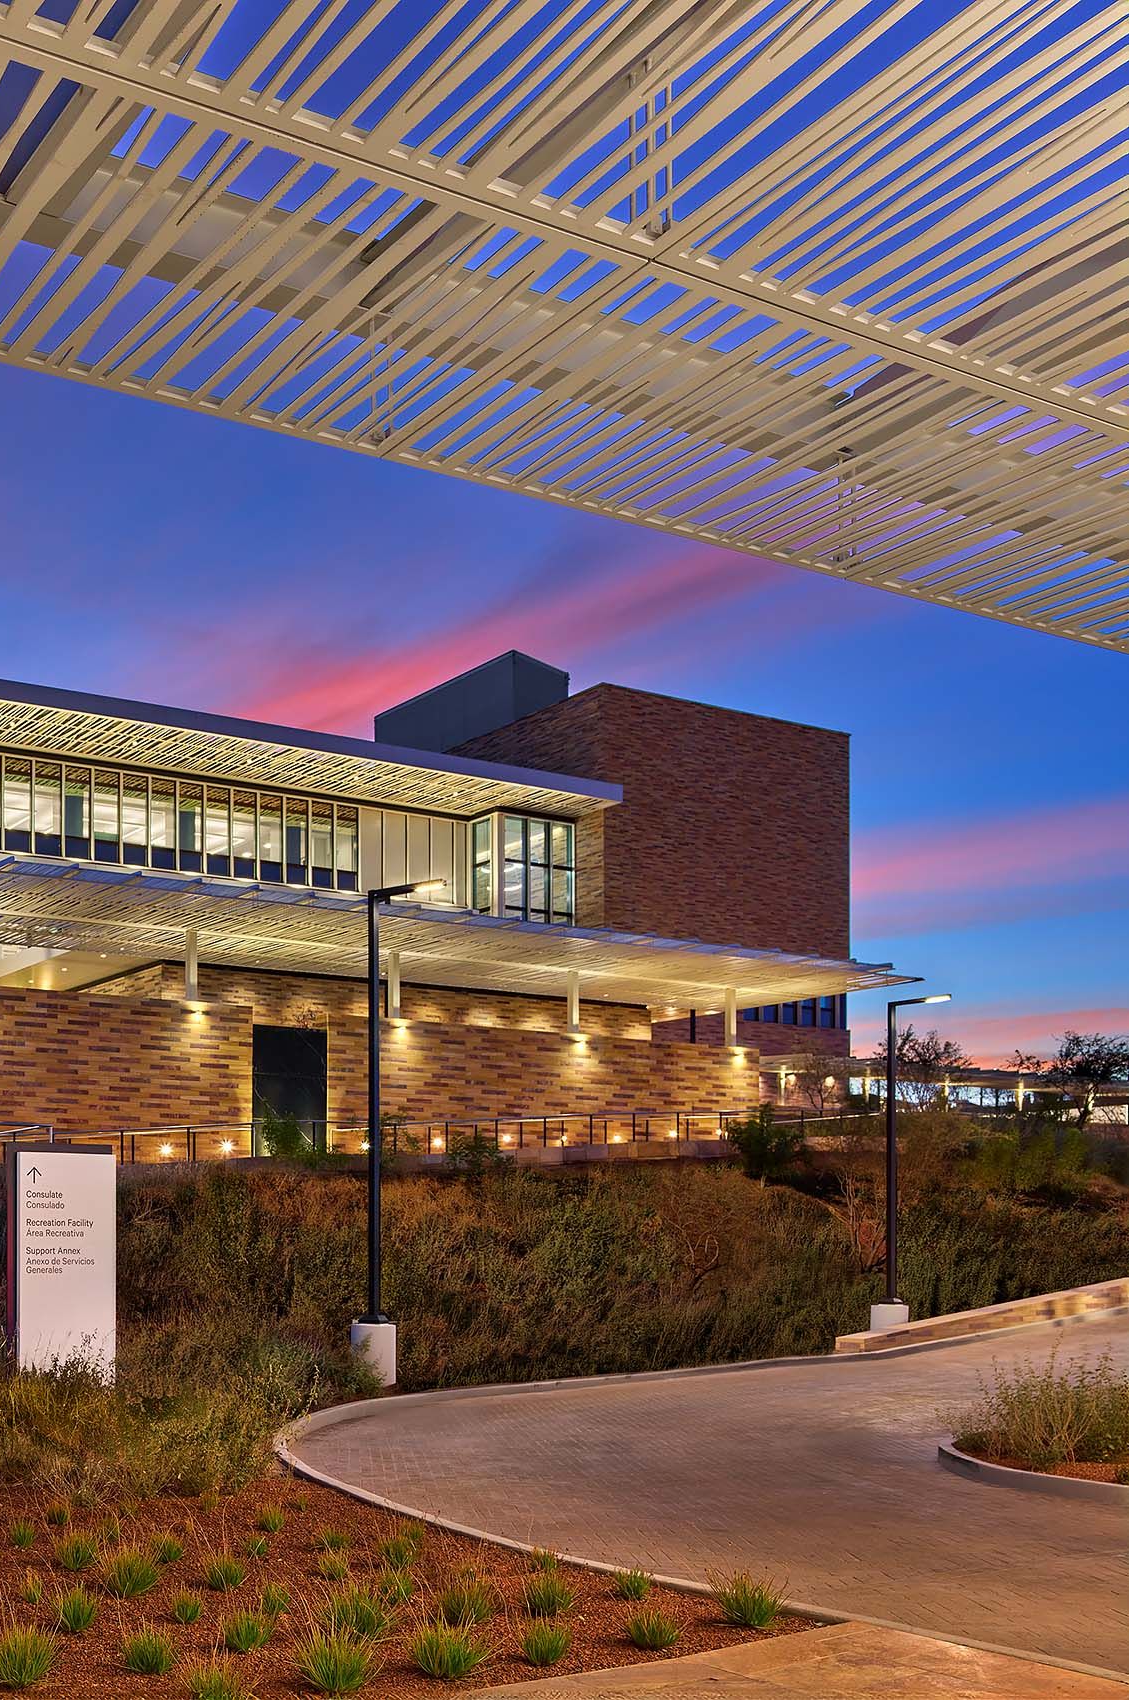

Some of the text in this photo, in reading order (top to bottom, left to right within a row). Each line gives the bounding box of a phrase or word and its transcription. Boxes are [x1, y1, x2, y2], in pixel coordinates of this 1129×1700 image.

[26, 1190, 63, 1199] Consulate
[26, 1201, 65, 1209] Consulado
[26, 1219, 94, 1228] Recreation Facility
[45, 1229, 84, 1238] Recreativa
[26, 1247, 81, 1256] Support Annex
[62, 1258, 95, 1266] Servicios
[26, 1266, 63, 1274] Generales
